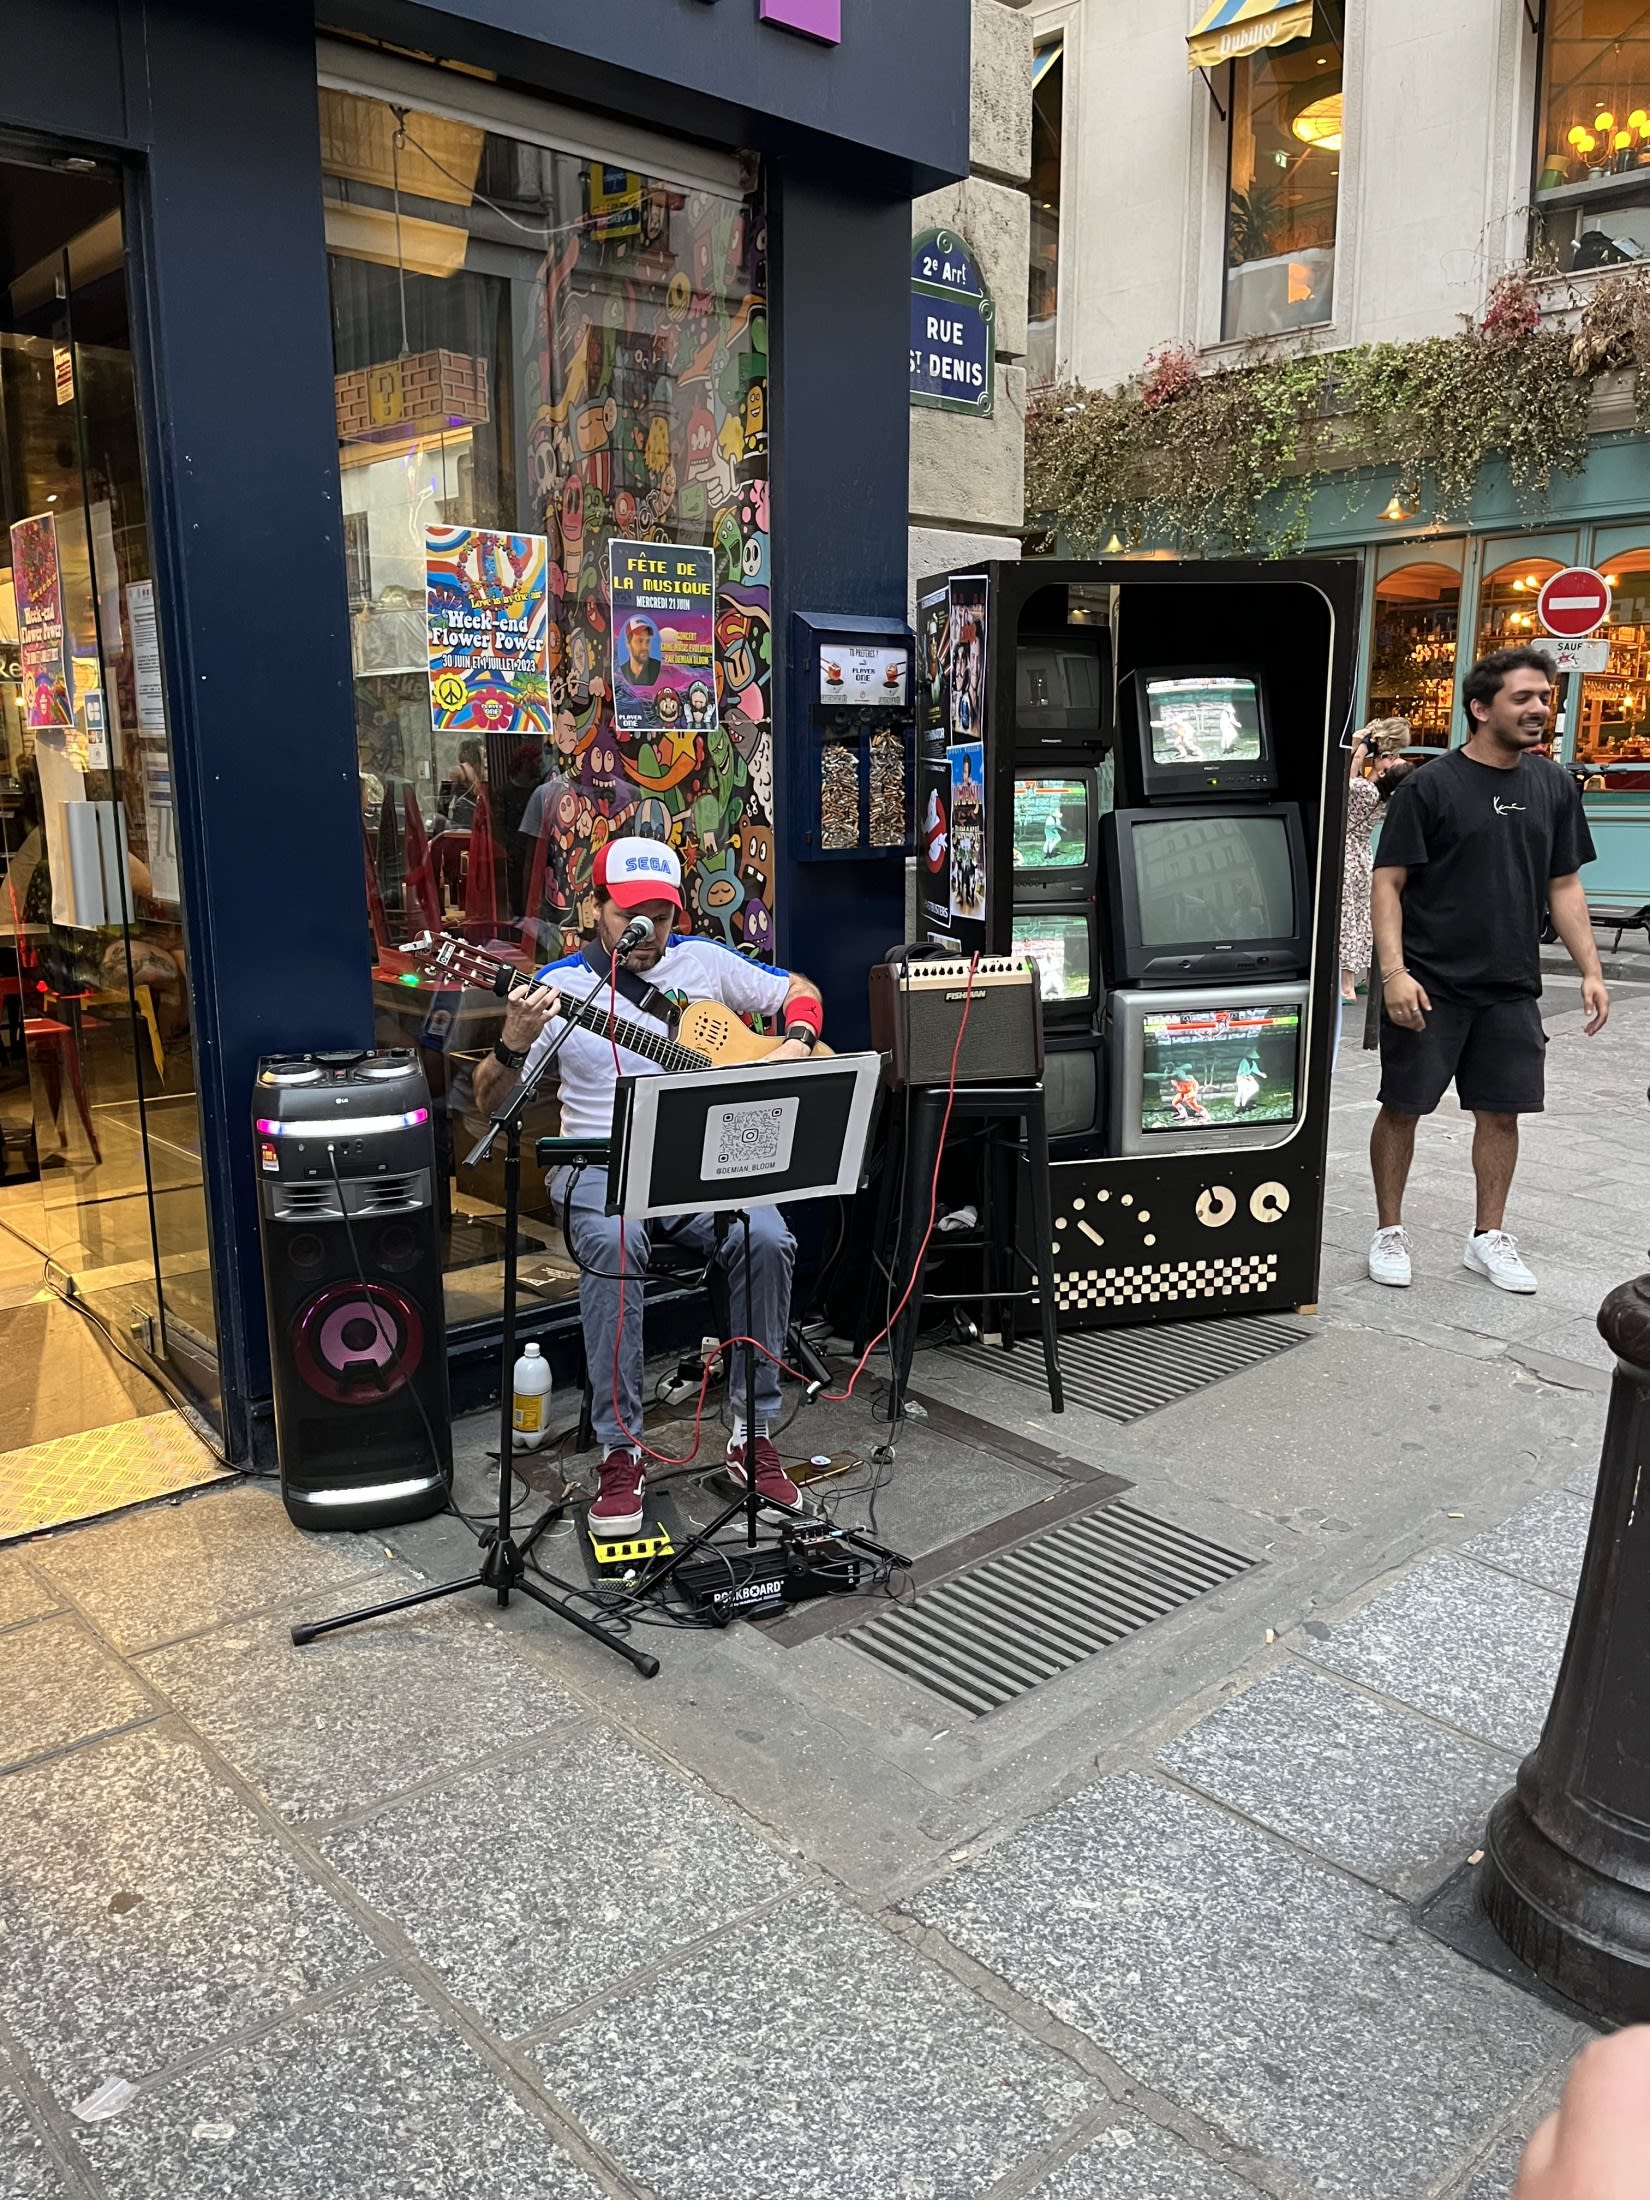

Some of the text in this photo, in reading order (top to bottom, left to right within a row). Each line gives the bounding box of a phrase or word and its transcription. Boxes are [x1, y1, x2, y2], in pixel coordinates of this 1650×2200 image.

[926, 316, 963, 345] RUE
[929, 353, 983, 386] DENIS
[627, 551, 697, 576] FÊTE DE
[613, 576, 711, 595] LA MUSIQUE
[468, 595, 491, 609] Love
[492, 596, 501, 605] is
[515, 591, 529, 602] the
[636, 595, 690, 611] MERCREDI 21 JUIN
[442, 609, 528, 633] Week-end
[432, 627, 544, 651] Flower Power
[1557, 642, 1584, 651] SAUF
[442, 655, 453, 668] 30
[453, 655, 470, 668] JUIN
[472, 656, 481, 669] ET
[488, 657, 515, 671] JUILLET
[516, 658, 536, 672] 2023
[855, 674, 870, 682] ONE
[625, 856, 671, 875] SEGA
